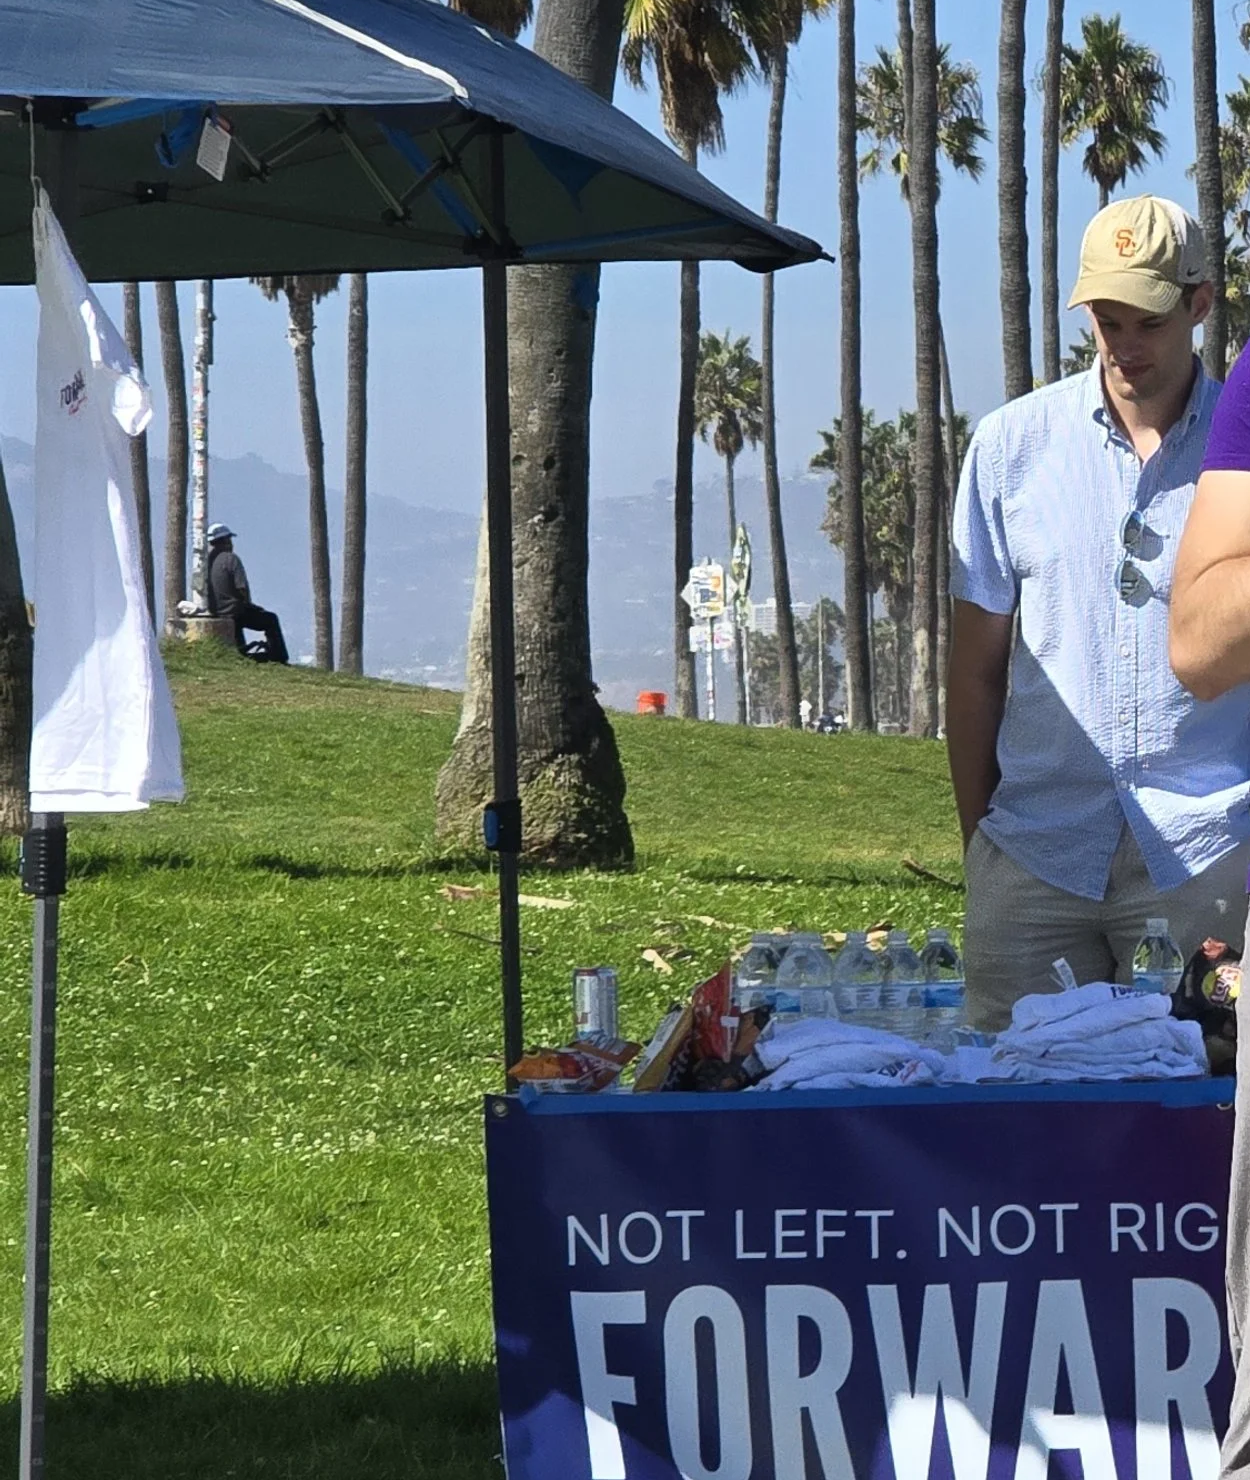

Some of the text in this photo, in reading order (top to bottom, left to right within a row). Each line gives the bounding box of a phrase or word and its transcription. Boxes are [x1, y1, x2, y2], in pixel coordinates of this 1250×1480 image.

[1115, 229, 1136, 258] SC
[566, 1201, 1220, 1266] NOT LEFT. NOT RIG
